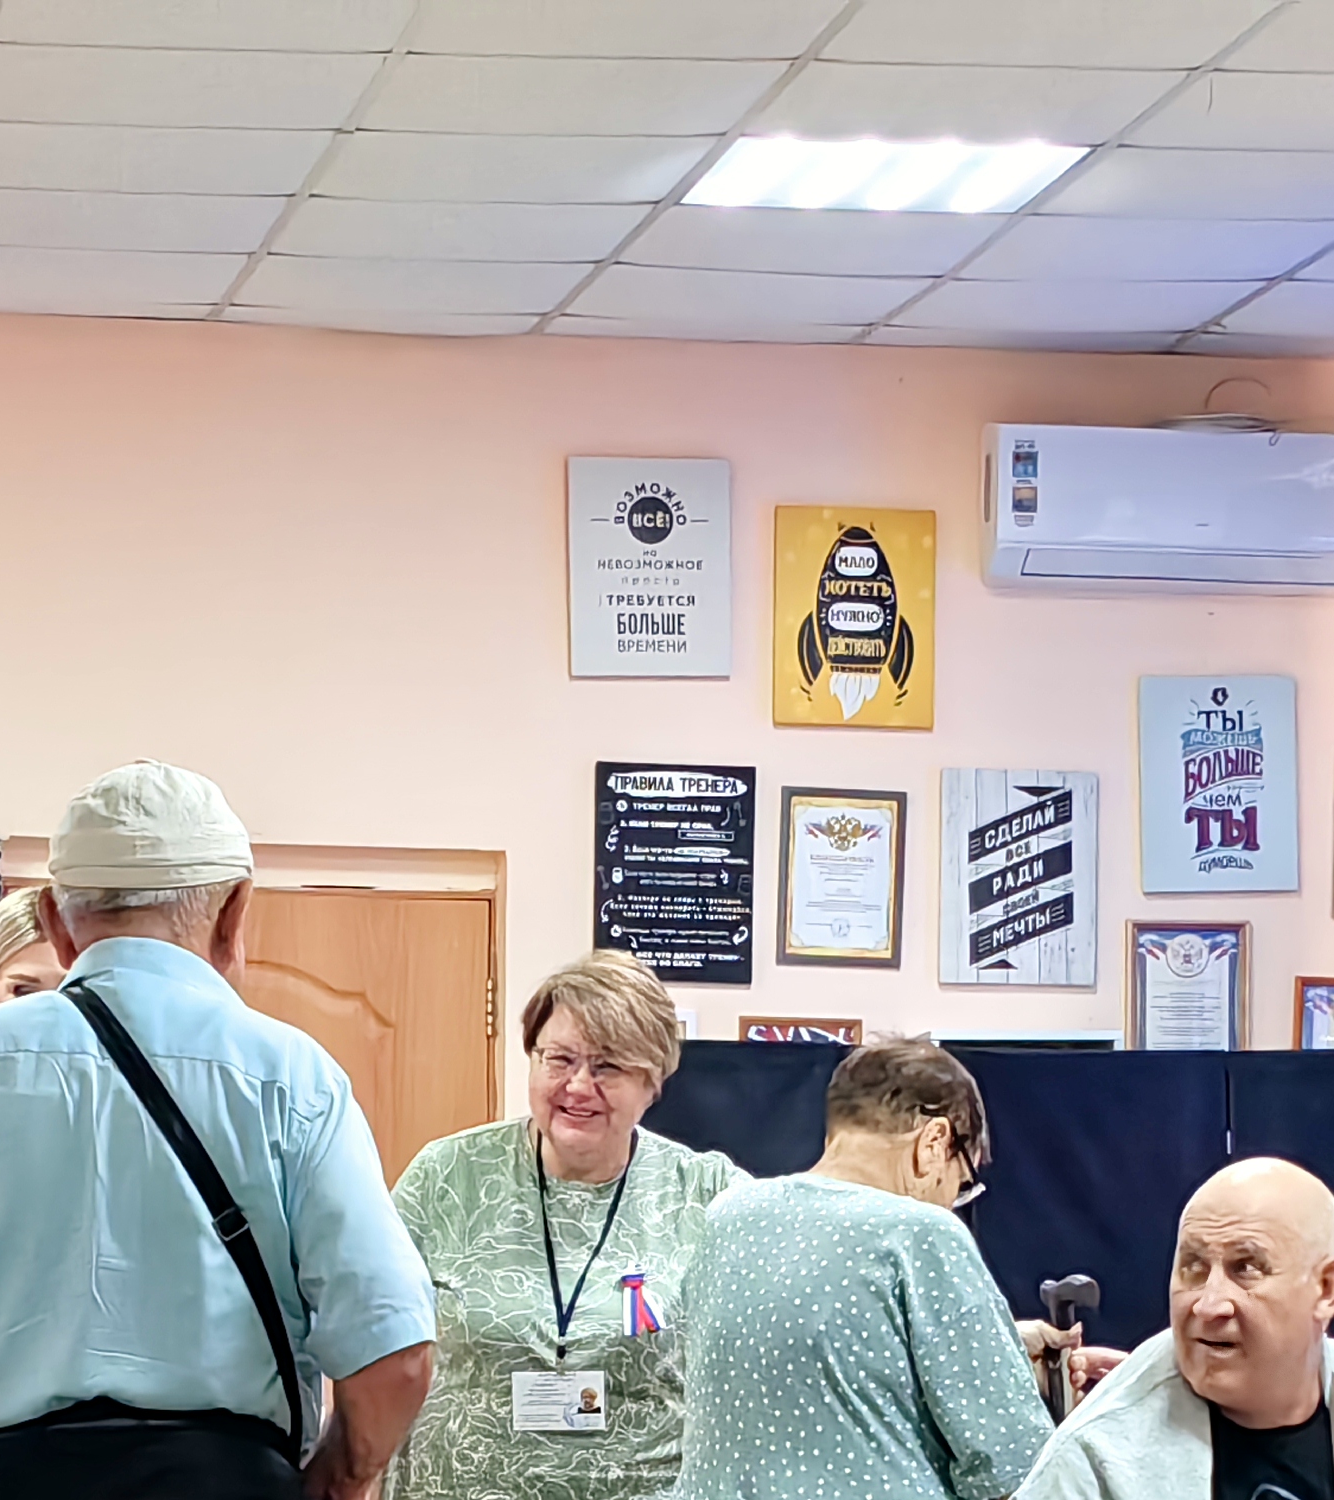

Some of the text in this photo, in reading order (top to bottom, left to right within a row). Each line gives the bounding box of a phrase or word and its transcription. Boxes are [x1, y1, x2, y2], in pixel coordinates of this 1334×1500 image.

[613, 482, 687, 525] ВОЗМОЖНО
[597, 559, 704, 570] НЕВОЗМОЖНОЕ
[838, 556, 876, 569] МАЛО
[824, 579, 892, 597] ХОТЕТЬ
[606, 593, 696, 606] ТРЕБУЕТСЯ
[617, 612, 686, 635] БОЛЬШЕ
[617, 639, 687, 653] ВРЕМЕНИ
[1197, 710, 1243, 732] ТЫ
[1183, 747, 1263, 799] БОЛЬШЕ
[613, 775, 739, 794] ПРАВИЛА ТРЕНЕРА
[984, 800, 1056, 850] СДЕЛАЙ
[1184, 805, 1261, 853] ТЫ
[992, 859, 1043, 895] РАДИ
[992, 906, 1051, 948] МЕЧТЫ
